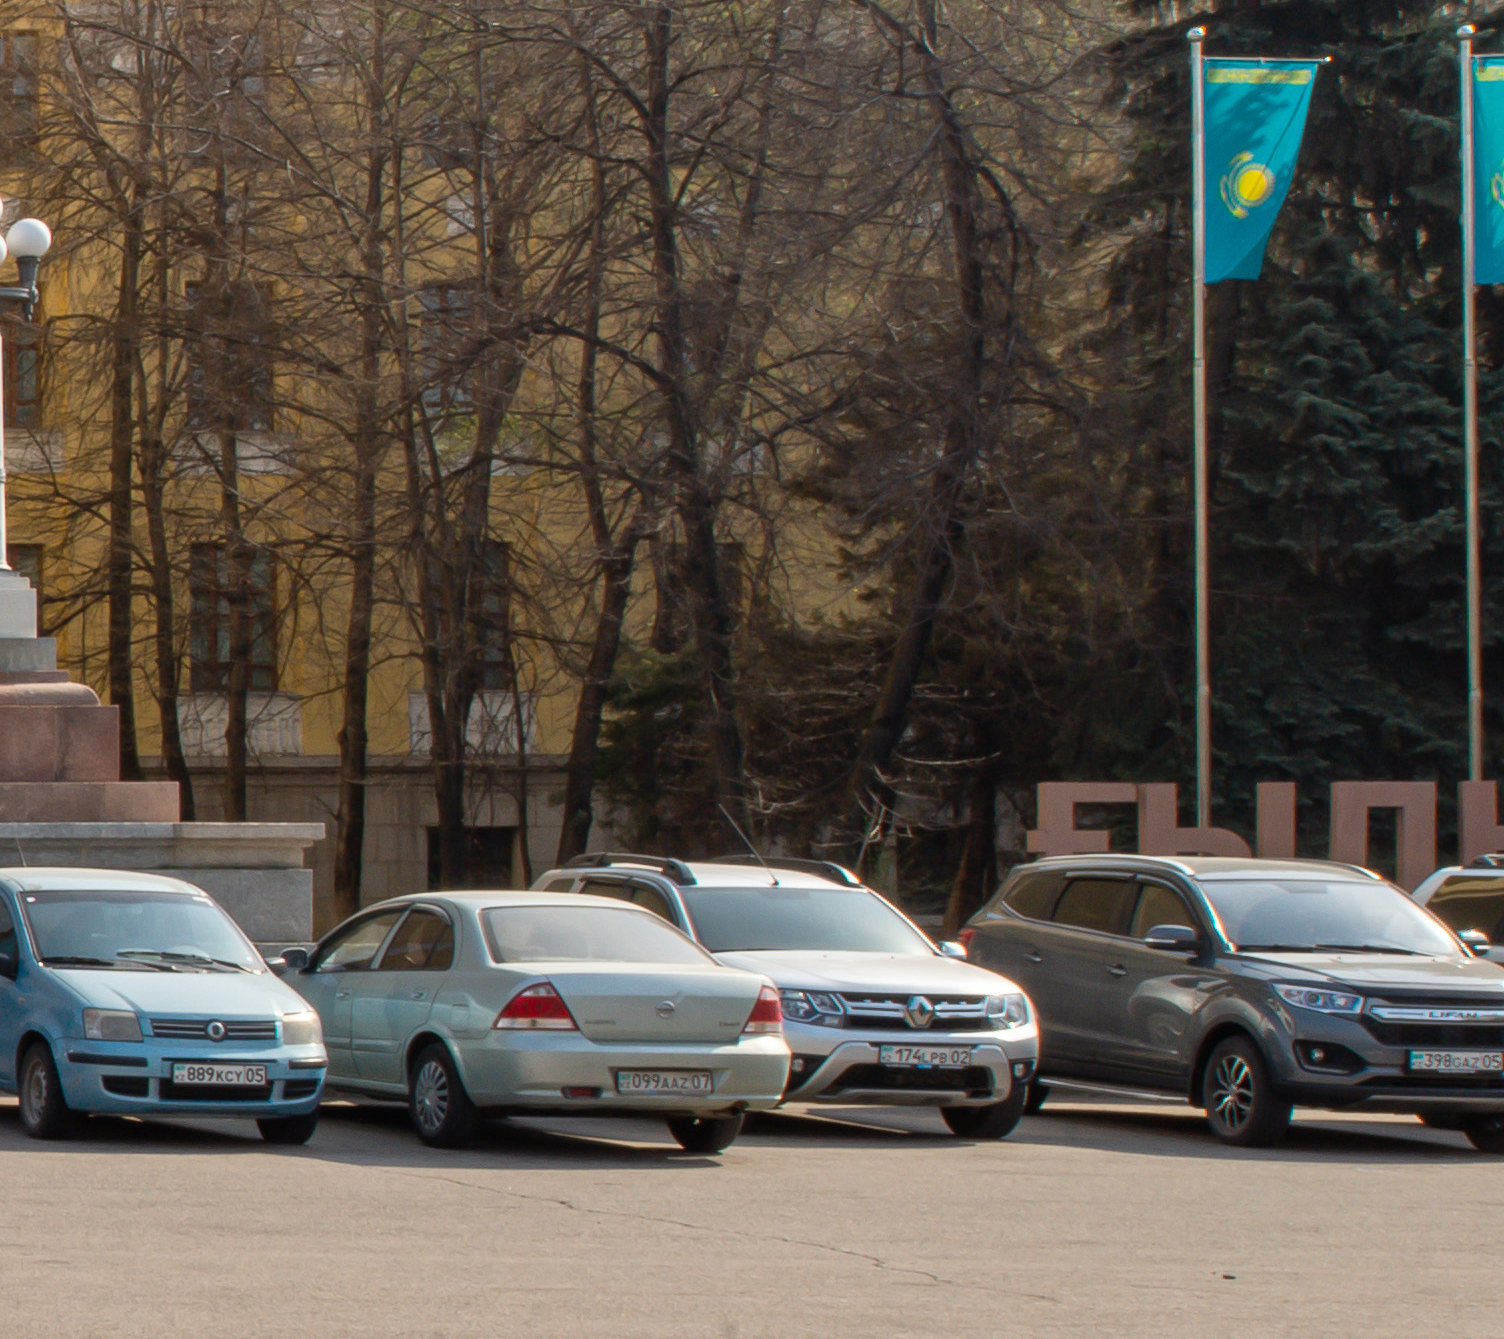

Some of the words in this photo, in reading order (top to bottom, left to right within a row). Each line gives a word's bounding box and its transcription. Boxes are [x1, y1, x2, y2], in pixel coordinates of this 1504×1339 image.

[951, 1050, 969, 1064] 02
[246, 1067, 264, 1083] 05
[691, 1074, 710, 1090] 07
